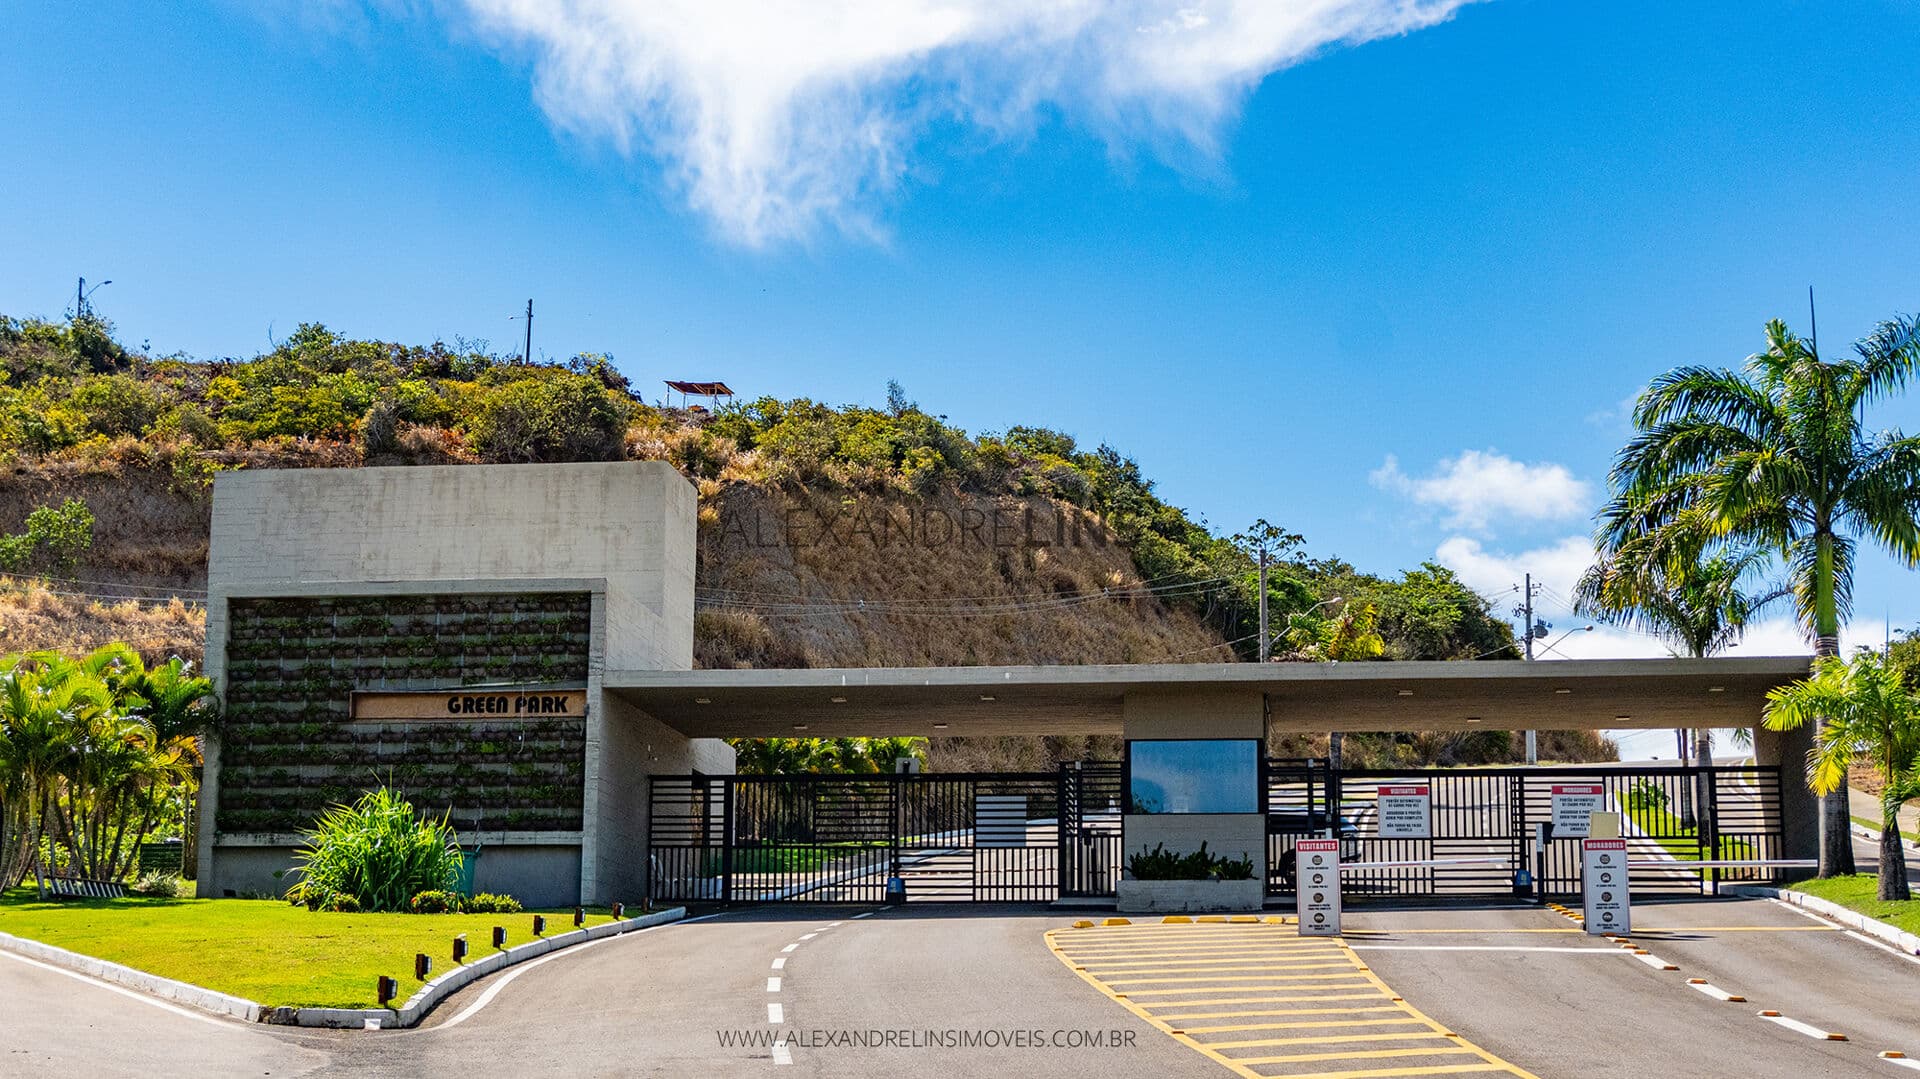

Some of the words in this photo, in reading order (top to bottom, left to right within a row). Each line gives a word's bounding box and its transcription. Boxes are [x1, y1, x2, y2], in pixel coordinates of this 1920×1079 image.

[447, 696, 508, 714] GREEN
[515, 695, 569, 713] PARK
[1299, 842, 1337, 850] VISITANTES
[1586, 841, 1625, 849] MORADORES
